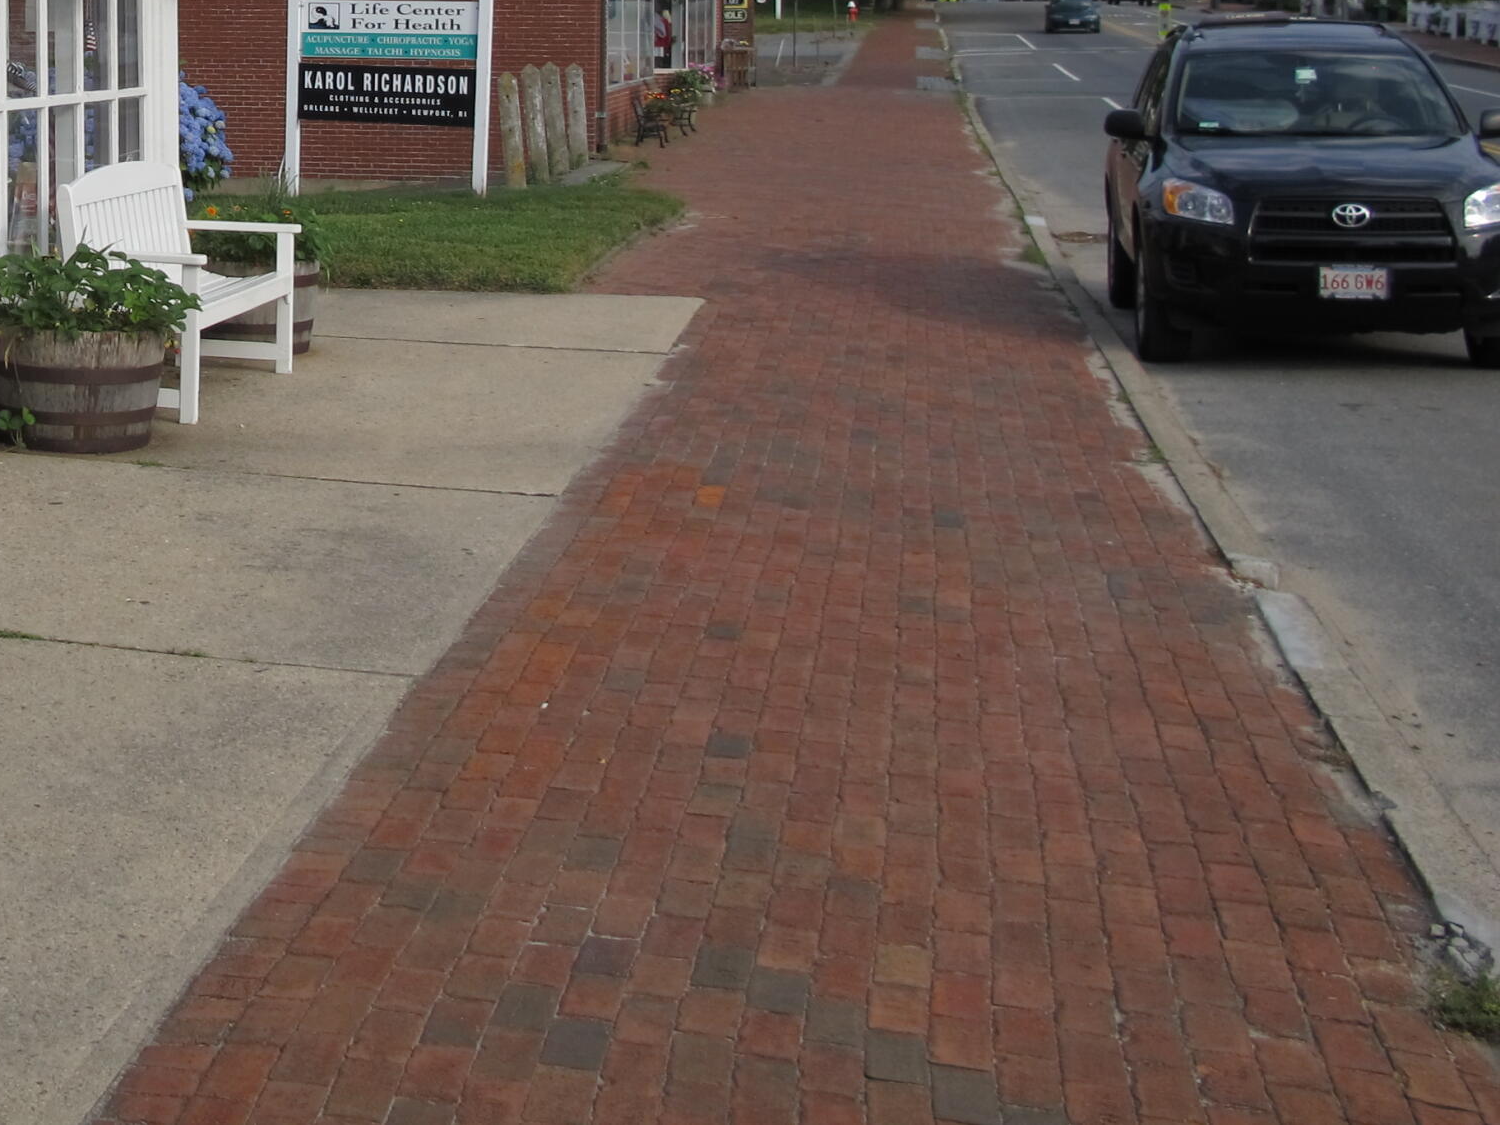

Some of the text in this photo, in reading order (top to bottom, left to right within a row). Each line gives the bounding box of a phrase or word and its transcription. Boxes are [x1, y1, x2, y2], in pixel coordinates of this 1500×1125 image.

[350, 3, 465, 16] Life Center
[351, 18, 461, 31] For Health
[306, 35, 474, 45] ACUPUNCTURE CHIROPRACTIC YOGA
[314, 47, 461, 57] MASSAGE TAI CHI HYPNOSIS
[304, 70, 469, 95] KAROL RICHARDSON
[329, 94, 370, 103] CLOTHING
[384, 97, 441, 106] ACCESSORIES
[303, 104, 340, 112] ORLEANS
[352, 107, 398, 115] WELLFLEET
[1320, 274, 1350, 290] 166
